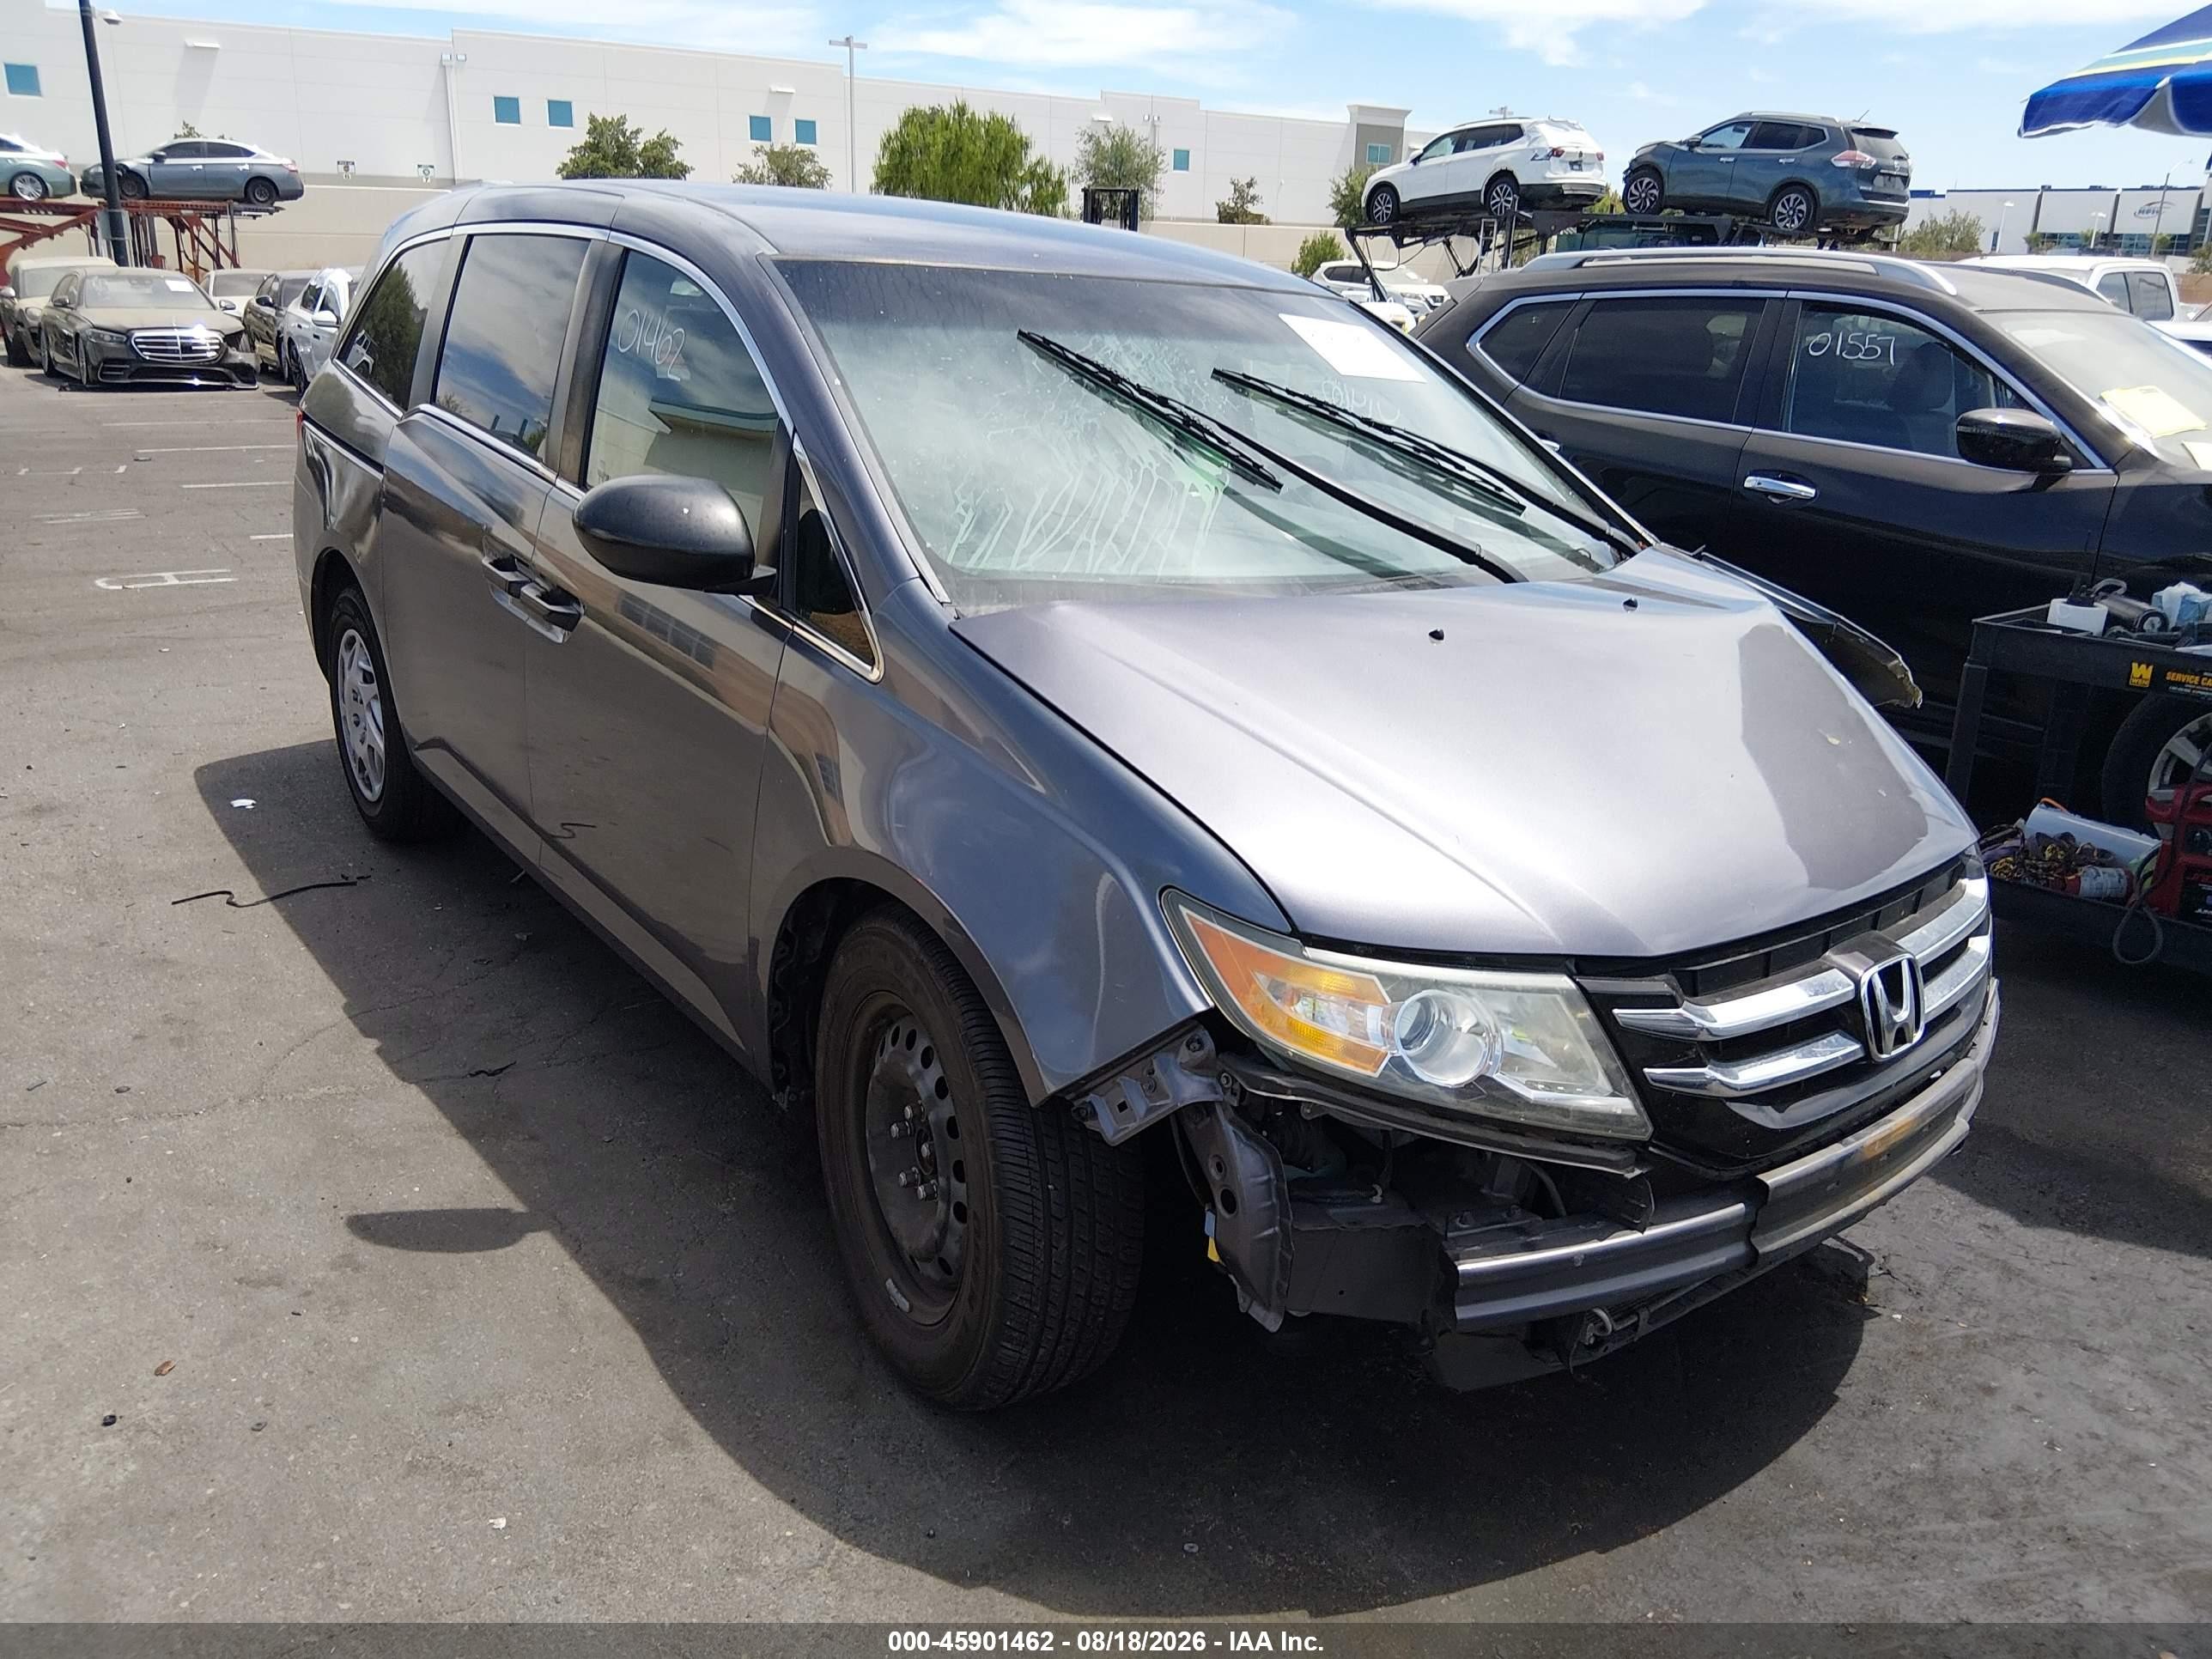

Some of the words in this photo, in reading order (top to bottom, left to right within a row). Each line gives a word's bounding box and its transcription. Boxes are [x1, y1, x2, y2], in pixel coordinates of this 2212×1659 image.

[618, 309, 685, 381] 01462
[1808, 332, 1896, 366] 01557
[2166, 672, 2199, 685] SERVICE
